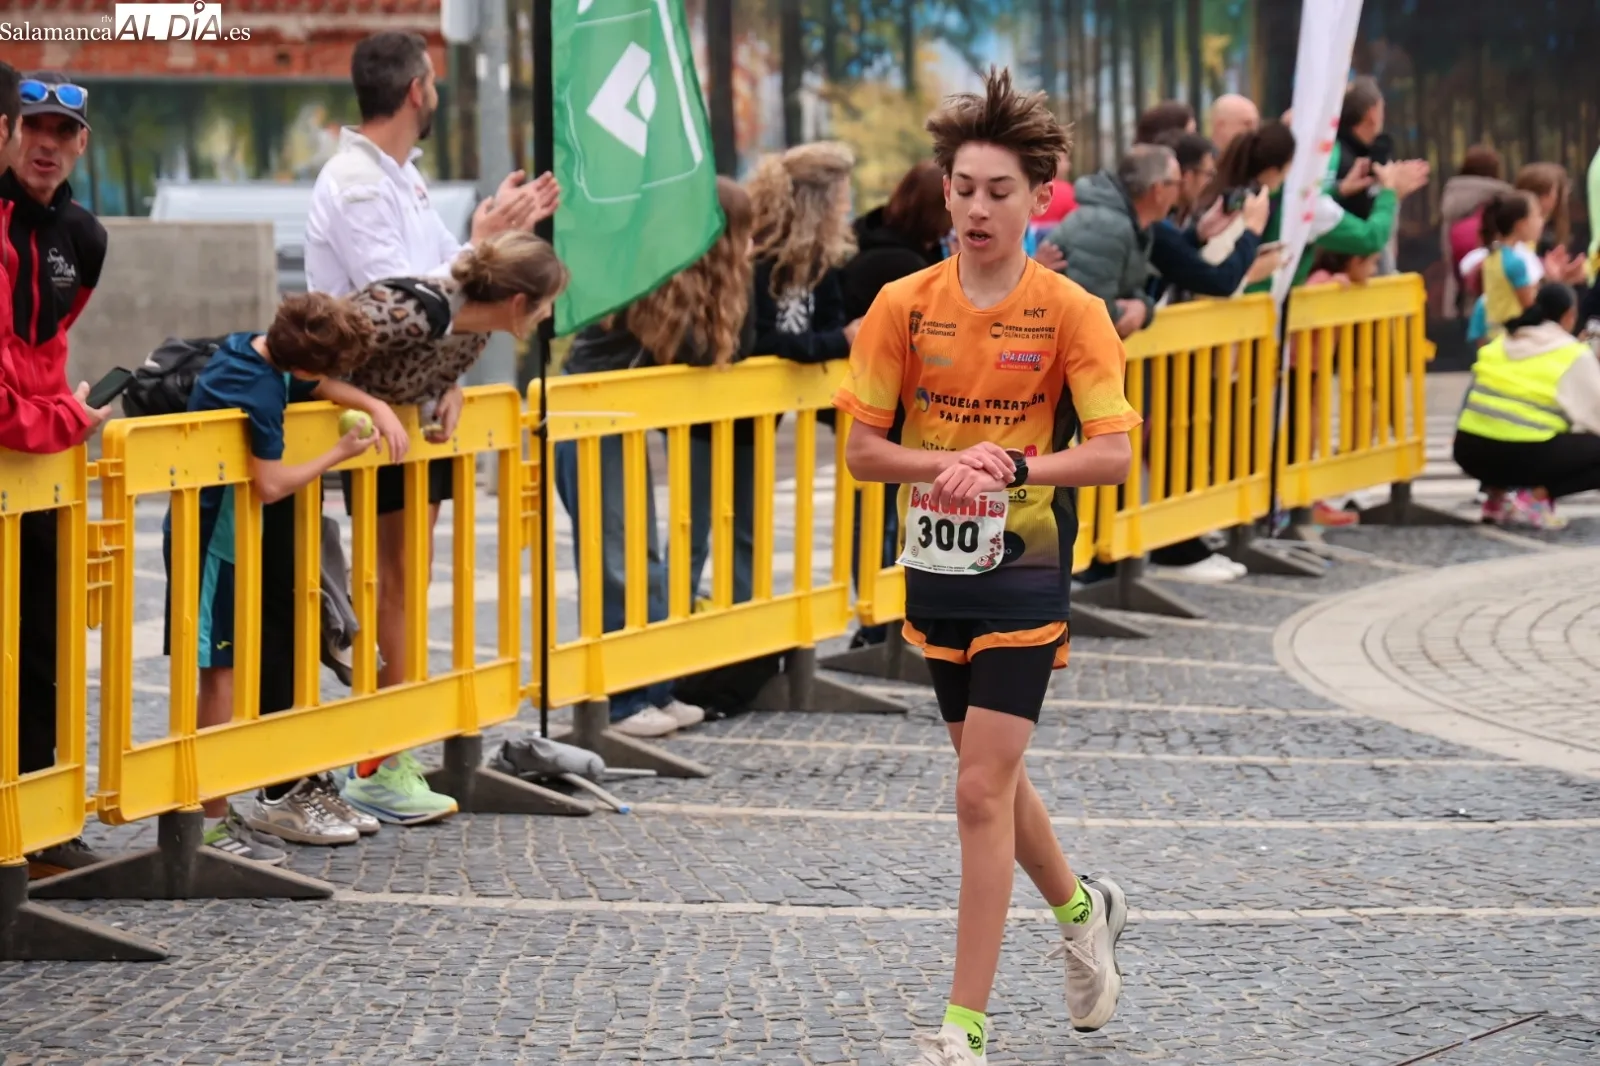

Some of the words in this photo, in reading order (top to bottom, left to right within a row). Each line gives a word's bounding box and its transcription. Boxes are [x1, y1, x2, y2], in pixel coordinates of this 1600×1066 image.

[930, 392, 980, 409] ESCUELA
[939, 410, 1026, 426] SALMANTINA
[918, 515, 980, 553] 300
